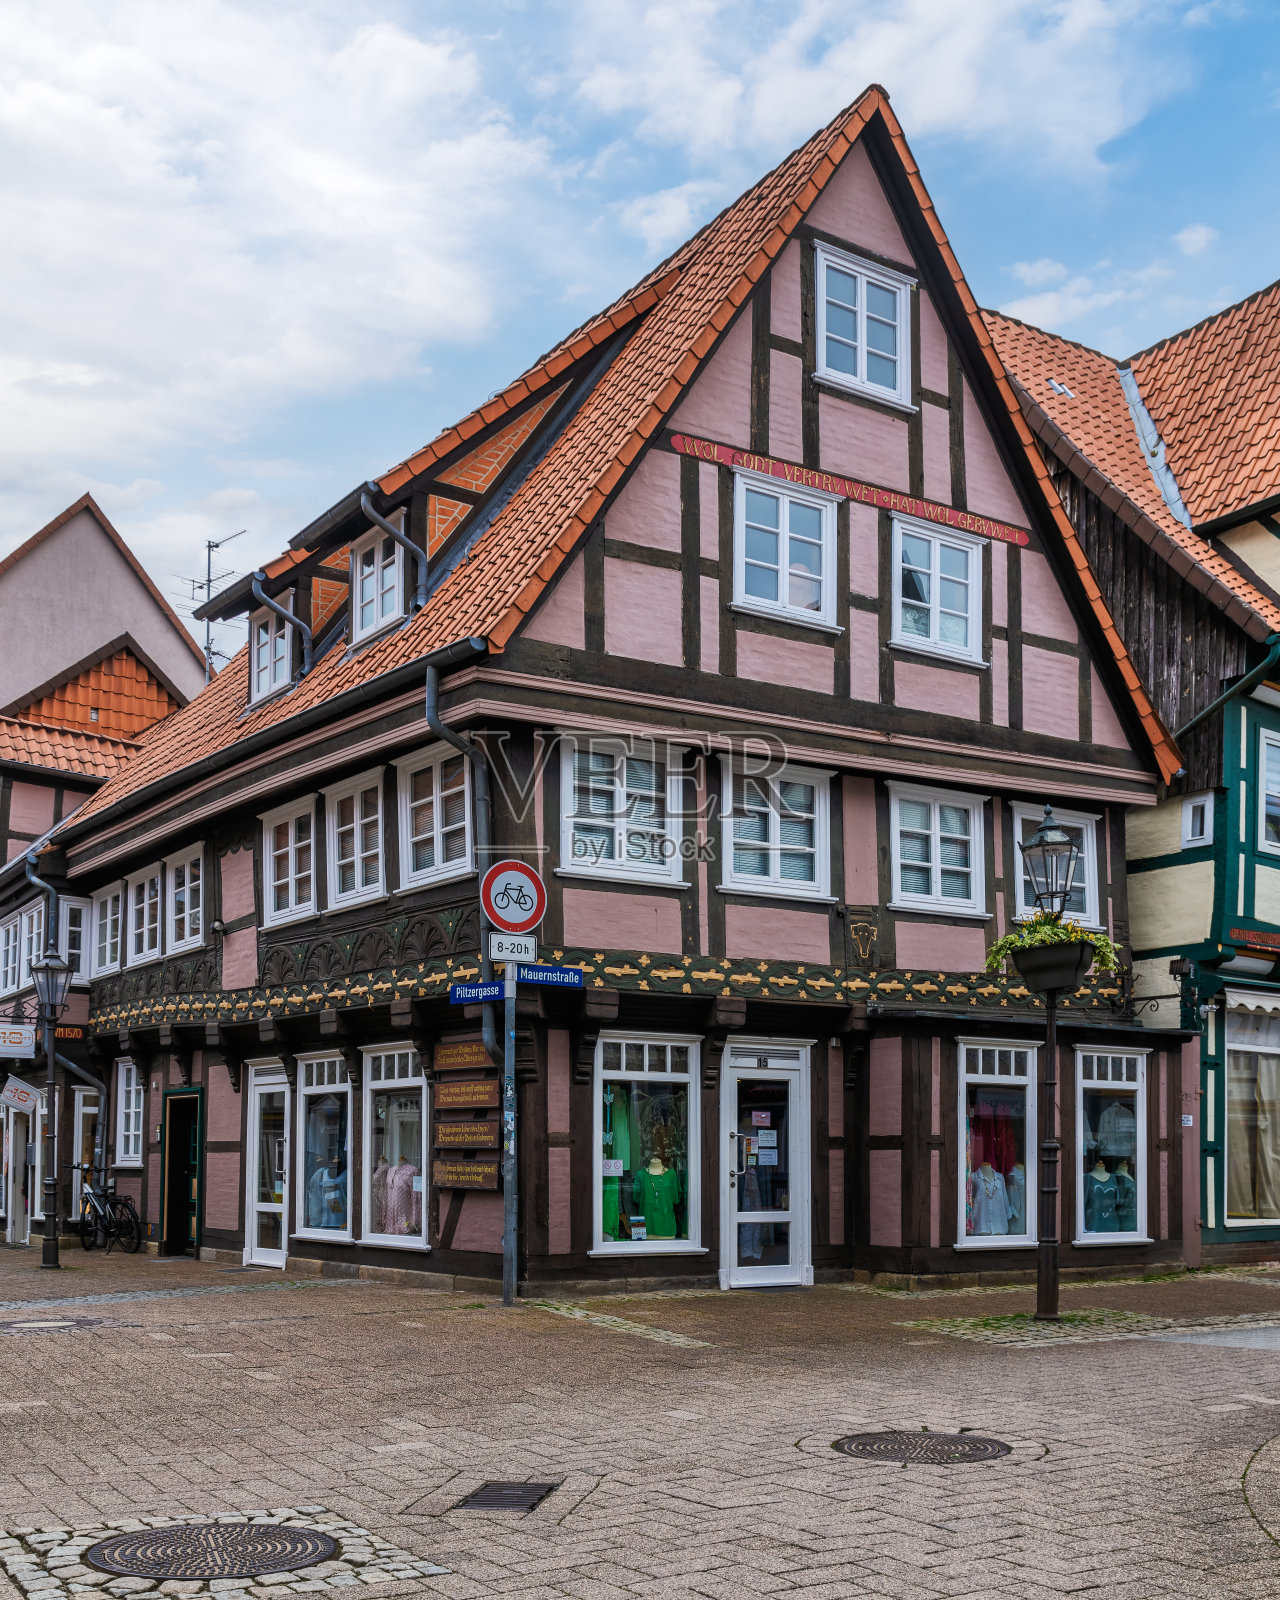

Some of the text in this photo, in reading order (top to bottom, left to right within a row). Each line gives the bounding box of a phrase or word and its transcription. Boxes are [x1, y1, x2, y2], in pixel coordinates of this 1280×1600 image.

[681, 435, 724, 463] WOL
[732, 451, 777, 475] GODT
[890, 494, 920, 514] HAT
[922, 502, 954, 525] WOL
[520, 967, 580, 984] Mauernstraße
[456, 986, 499, 1000] Piltzergasse
[65, 1027, 82, 1039] 1570
[758, 1057, 768, 1068] 15
